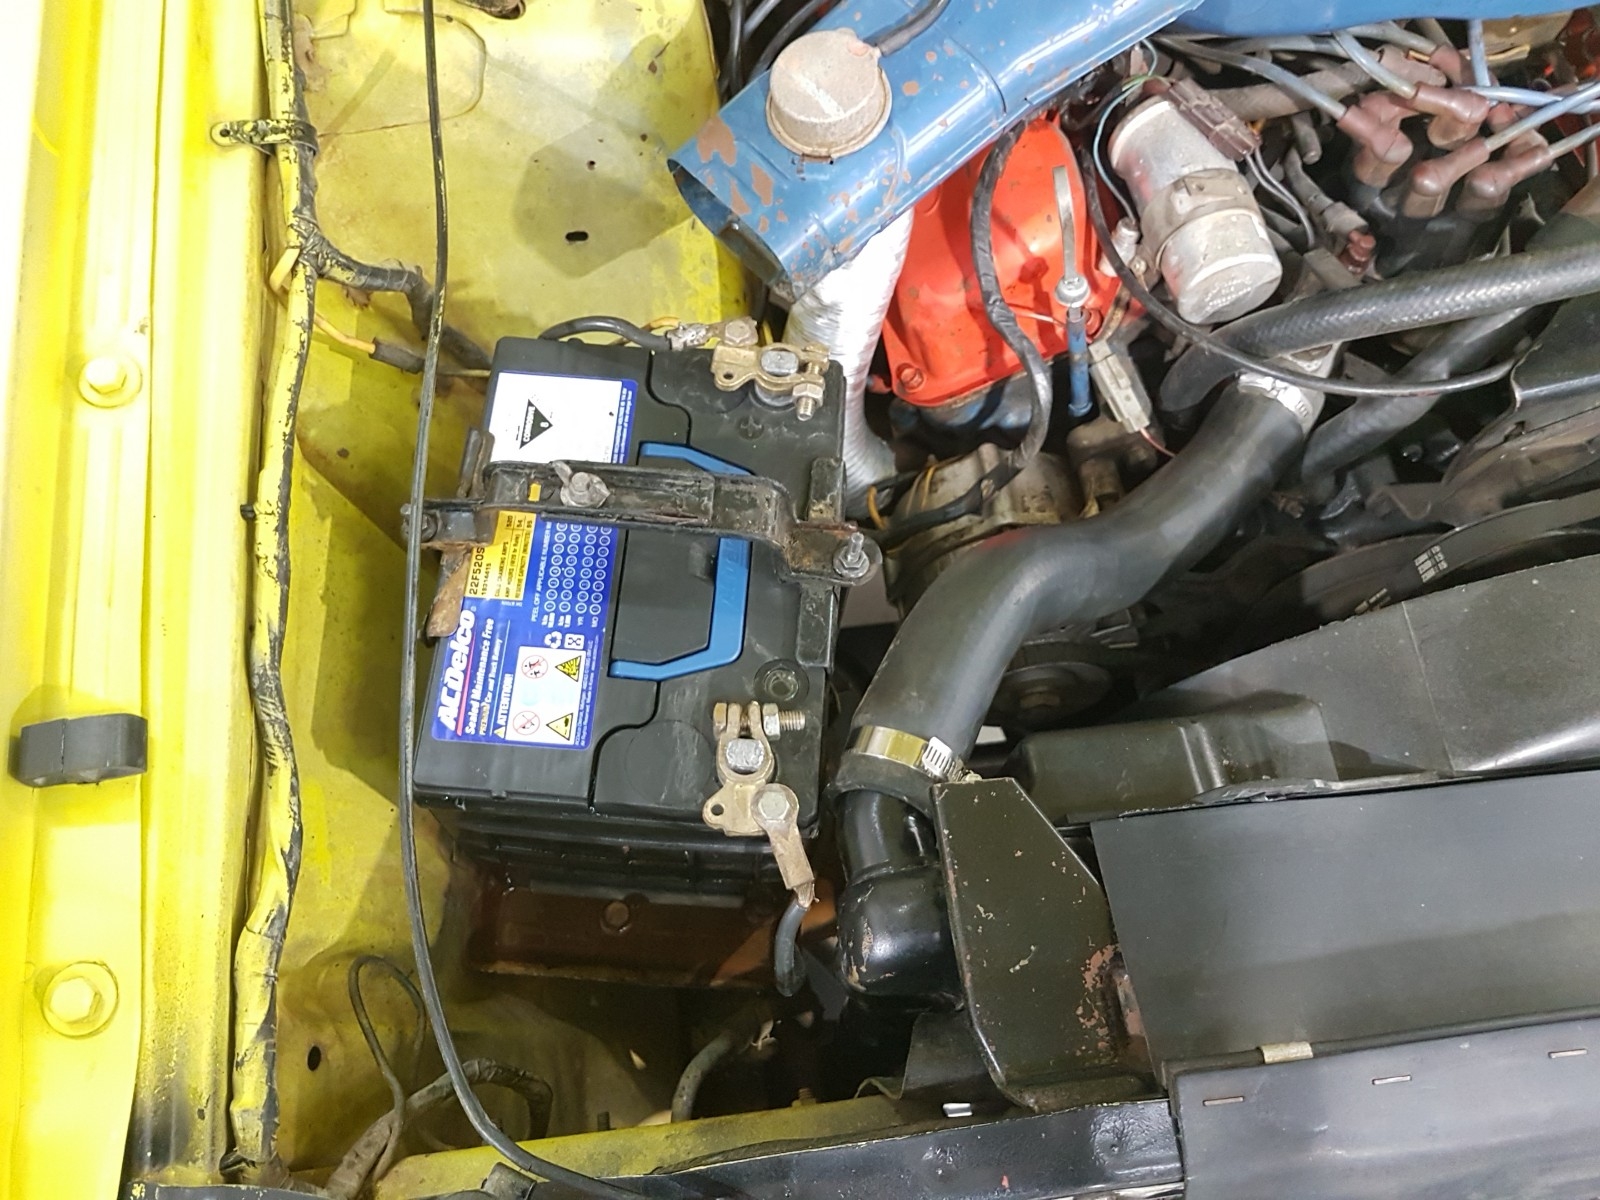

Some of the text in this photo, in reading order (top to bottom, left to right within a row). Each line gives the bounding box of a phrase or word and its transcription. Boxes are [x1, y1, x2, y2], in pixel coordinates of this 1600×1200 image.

[522, 406, 535, 441] CORROSIVE
[535, 555, 546, 591] APPLICABLE
[541, 529, 550, 554] NUMBER
[576, 616, 583, 626] YR
[591, 616, 598, 627] MO
[491, 638, 502, 660] Battery
[437, 609, 474, 730] ACDelco
[464, 618, 494, 734] Sealed Maintenance Free
[488, 661, 497, 677] Truck
[496, 673, 513, 725] ATTENTION!
